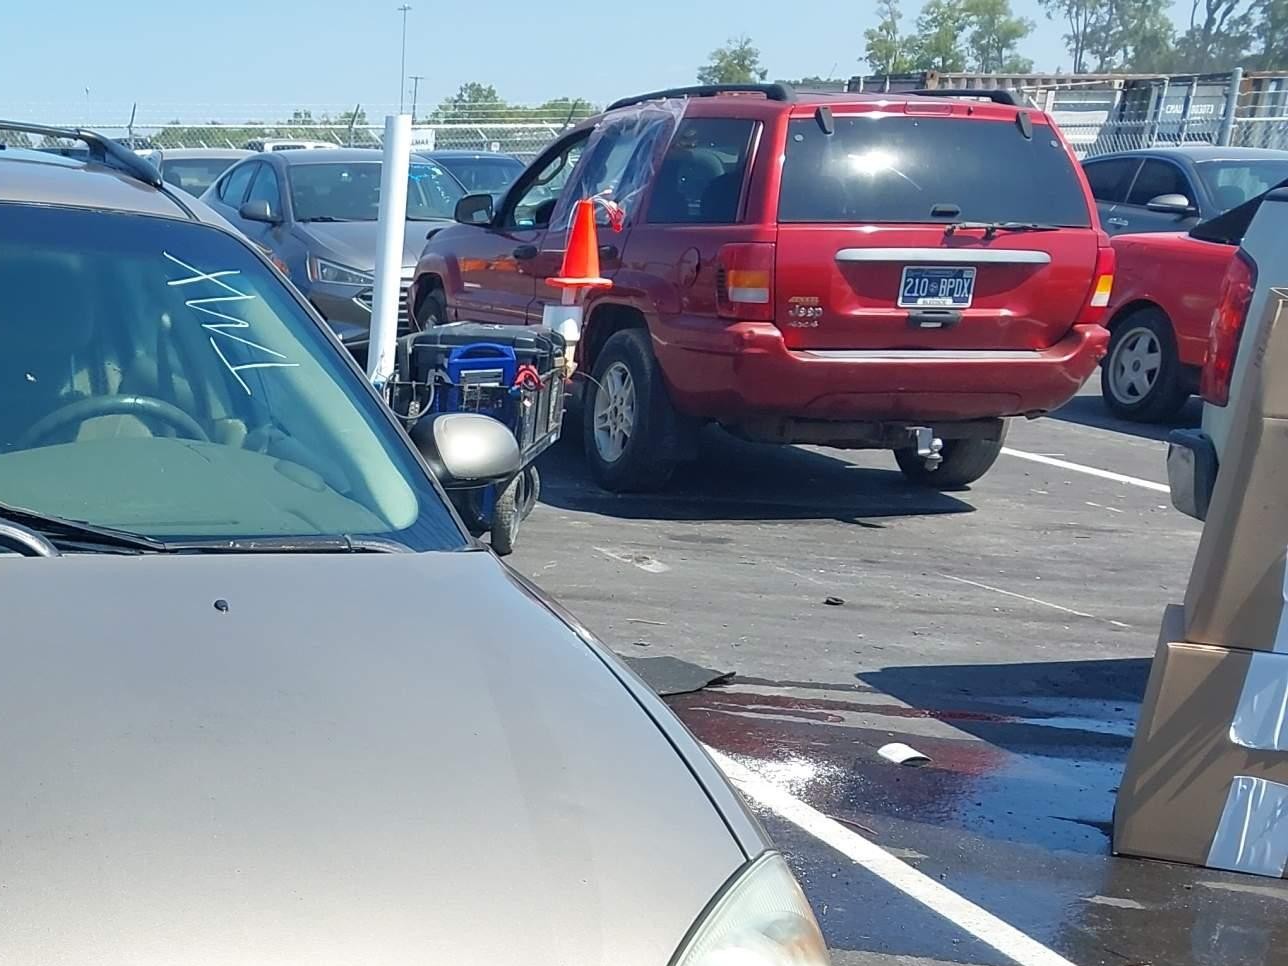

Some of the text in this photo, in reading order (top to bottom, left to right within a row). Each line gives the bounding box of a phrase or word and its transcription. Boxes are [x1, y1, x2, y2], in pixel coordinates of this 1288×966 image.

[904, 277, 972, 298] 210 BPDX
[788, 304, 823, 319] Jeep
[162, 250, 301, 396] TMX
